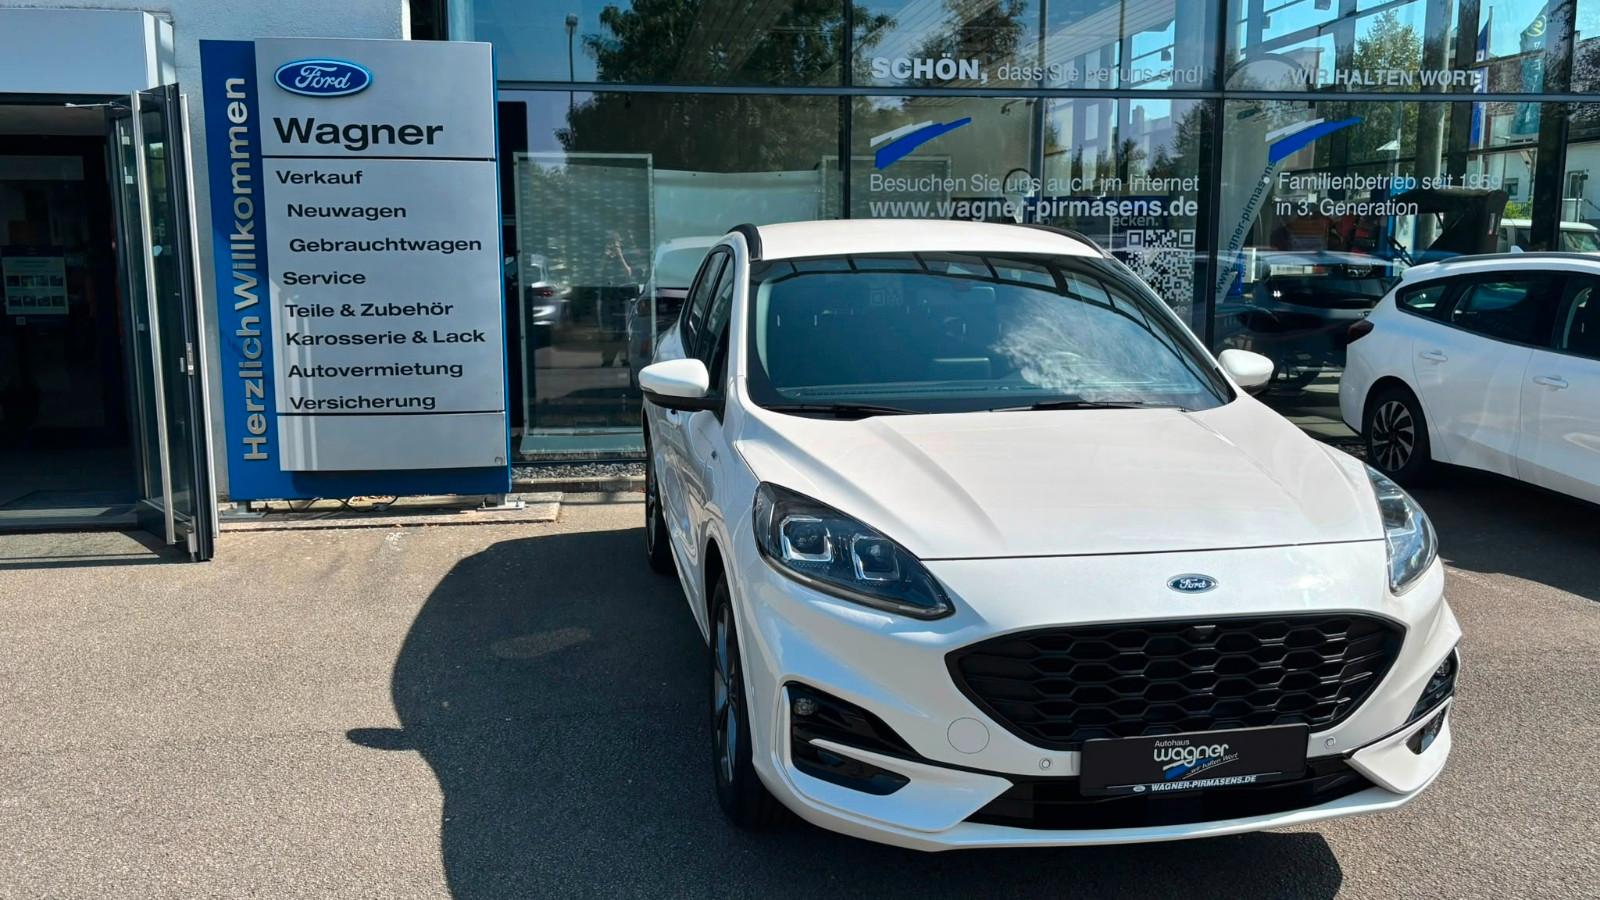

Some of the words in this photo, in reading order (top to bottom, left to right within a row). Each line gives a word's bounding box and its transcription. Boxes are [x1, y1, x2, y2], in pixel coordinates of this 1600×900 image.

[295, 65, 351, 89] Ford
[870, 54, 989, 84] SCHÖN,
[998, 63, 1043, 80] dass
[1049, 63, 1079, 81] Sie
[1121, 66, 1152, 82] uns
[1291, 69, 1329, 85] WIR
[1336, 69, 1414, 86] HALTEN
[273, 117, 444, 152] Wagner
[276, 170, 363, 184] Verkauf
[870, 173, 968, 193] Besuchen
[970, 173, 1000, 193] Sie
[1009, 177, 1041, 193] uns
[1047, 173, 1094, 193] auch
[1102, 173, 1122, 192] im
[1129, 173, 1200, 192] Internet
[1278, 172, 1416, 191] Familienbetrieb
[1422, 172, 1454, 191] seit
[1461, 173, 1501, 191] 1959
[226, 78, 259, 311] Willkommen
[287, 204, 406, 221] Neuwagen
[870, 197, 1199, 222] www.wagner-pirmasens.de
[1275, 198, 1291, 216] in
[1296, 199, 1314, 216] 3.
[1320, 198, 1418, 216] Generation
[289, 238, 482, 254] Gebrauchtwagen
[282, 271, 366, 285] Service
[285, 304, 335, 318] Teile
[340, 303, 356, 317] &
[360, 301, 454, 317] Zubehör
[286, 330, 407, 346] Karosserie
[412, 330, 428, 344] &
[432, 329, 486, 344] Lack
[288, 362, 464, 378] Autovermietung
[236, 316, 268, 460] Herzlich
[290, 395, 436, 410] Versicherung
[1154, 739, 1190, 748] Autohaus
[1153, 743, 1229, 768] wagner
[1151, 775, 1257, 792] WAGNER-PIRMASENS.DE
